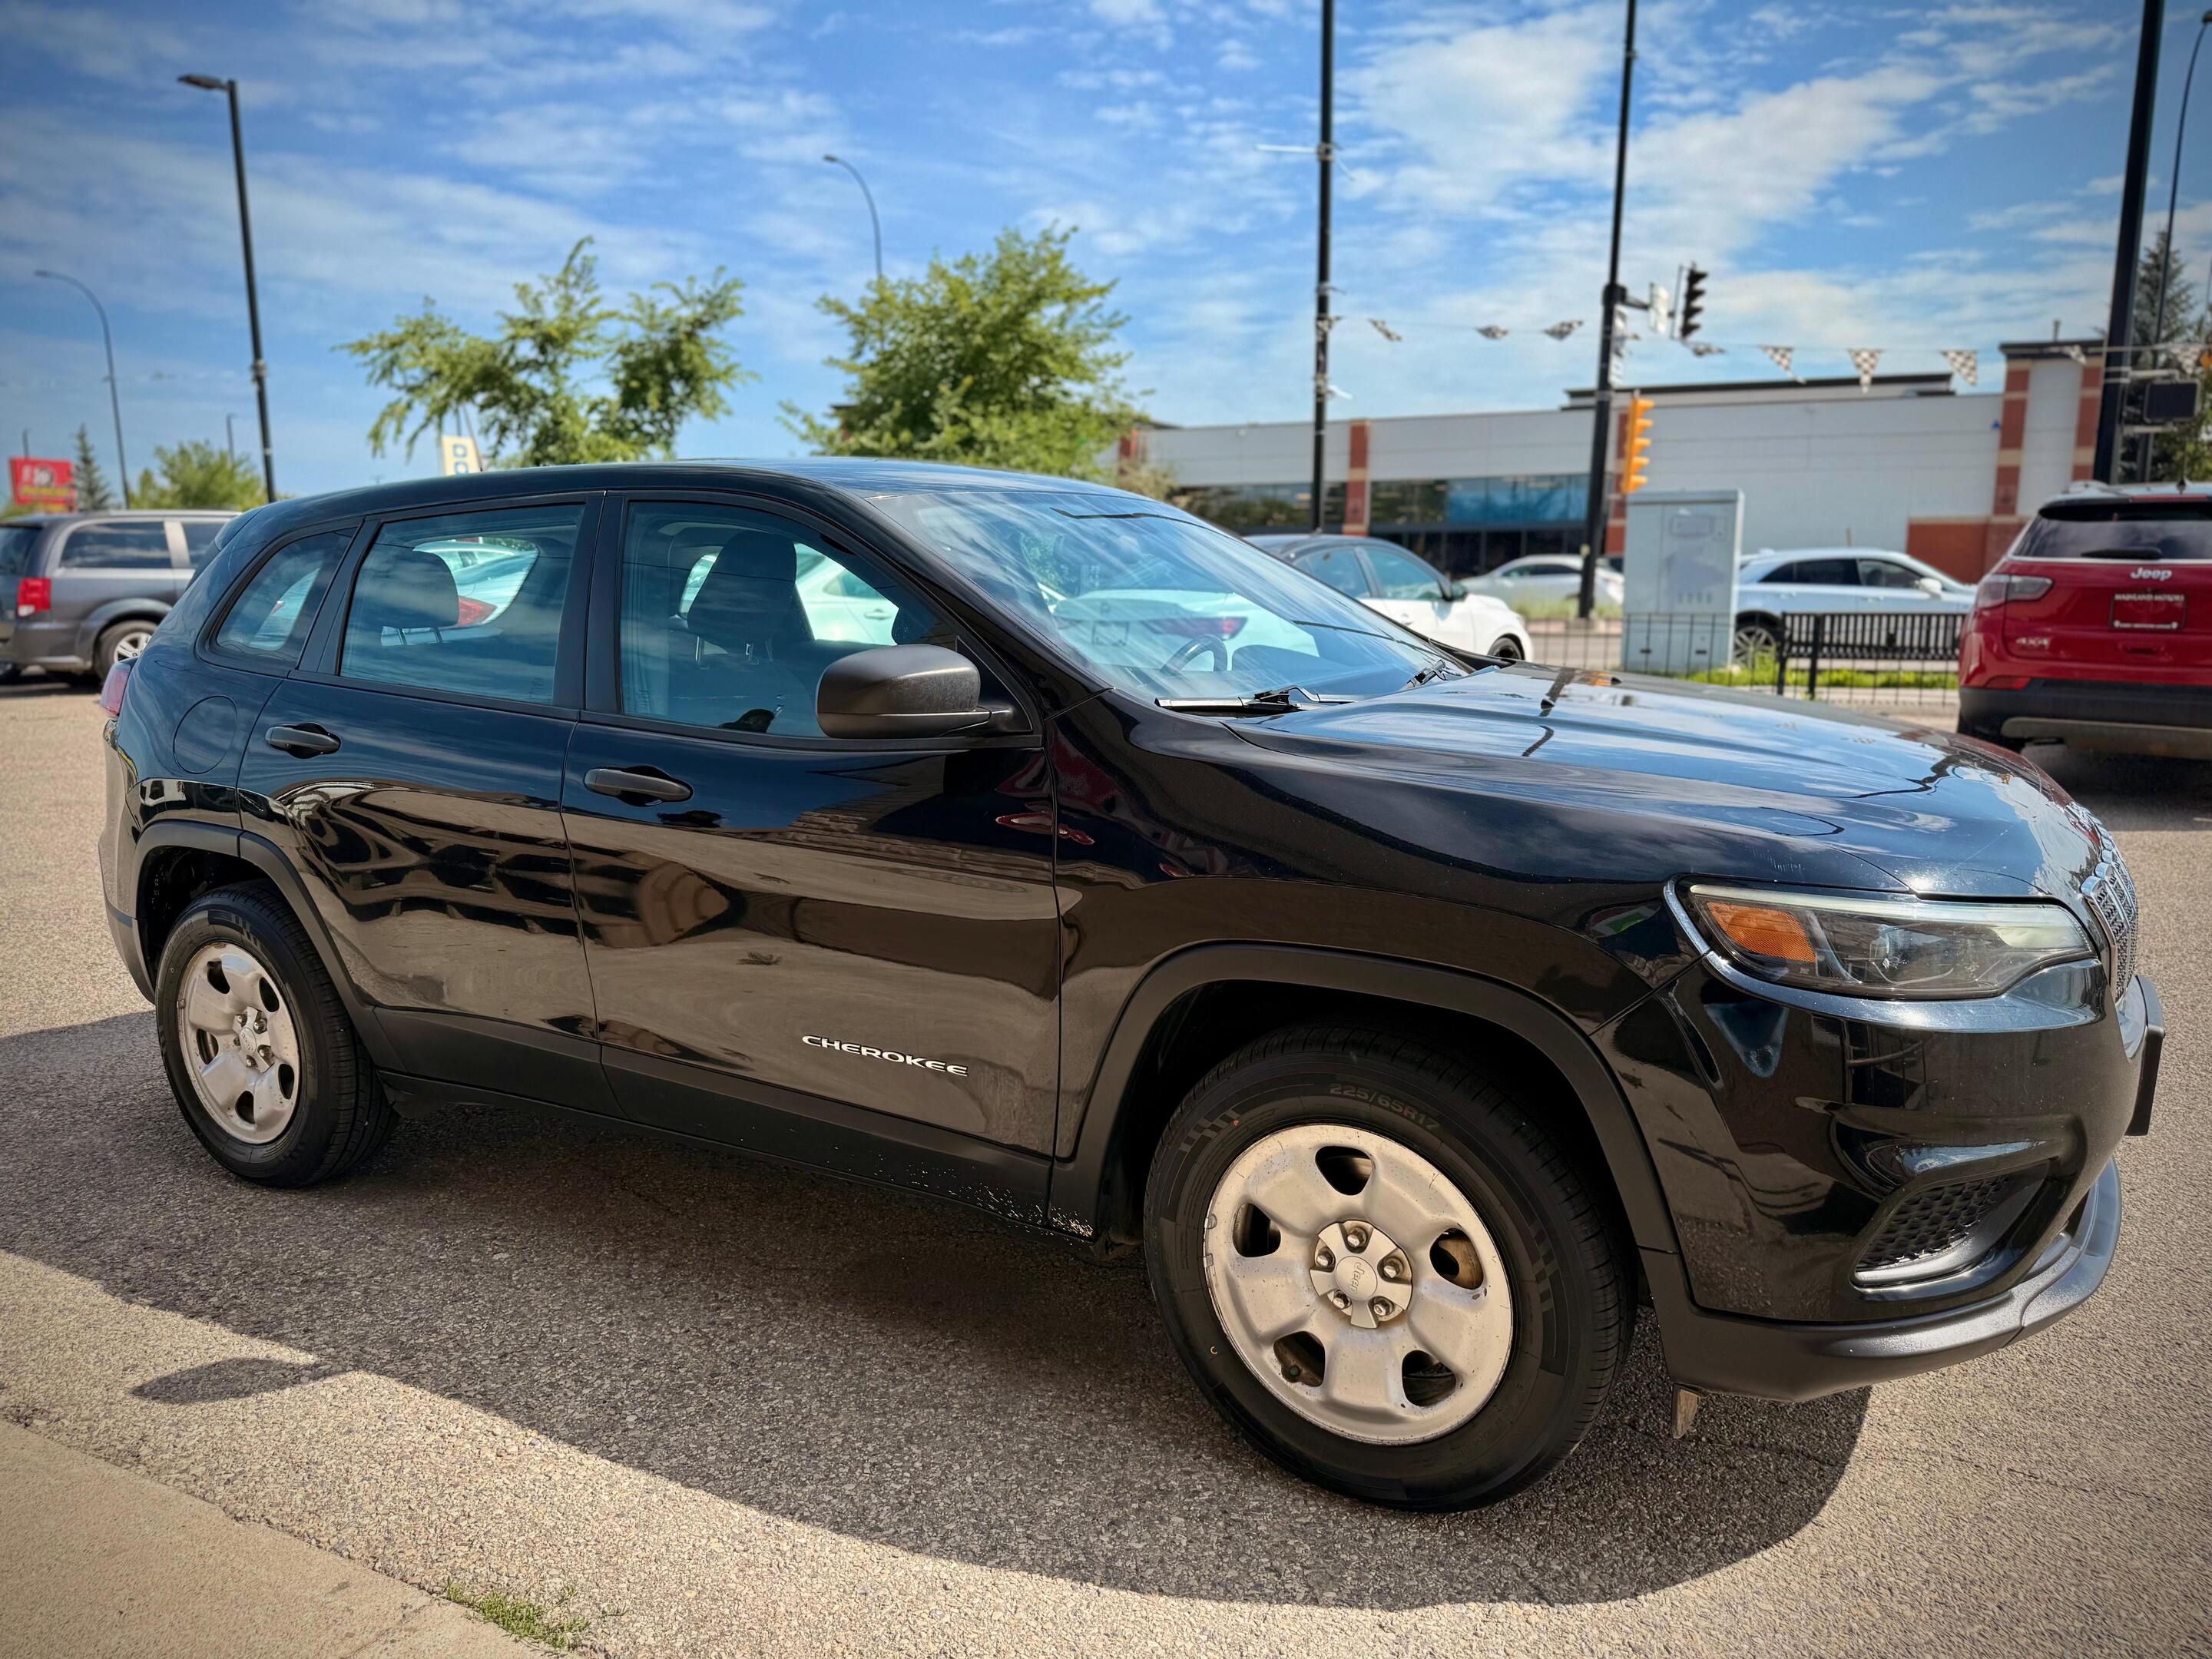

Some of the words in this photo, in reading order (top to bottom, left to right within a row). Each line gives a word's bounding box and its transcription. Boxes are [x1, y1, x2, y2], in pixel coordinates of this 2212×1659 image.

[2130, 567, 2172, 581] Jeep
[802, 1035, 968, 1077] CHEROKEE
[1330, 1083, 1440, 1130] 225/65R17
[1349, 1262, 1365, 1294] Jeep
